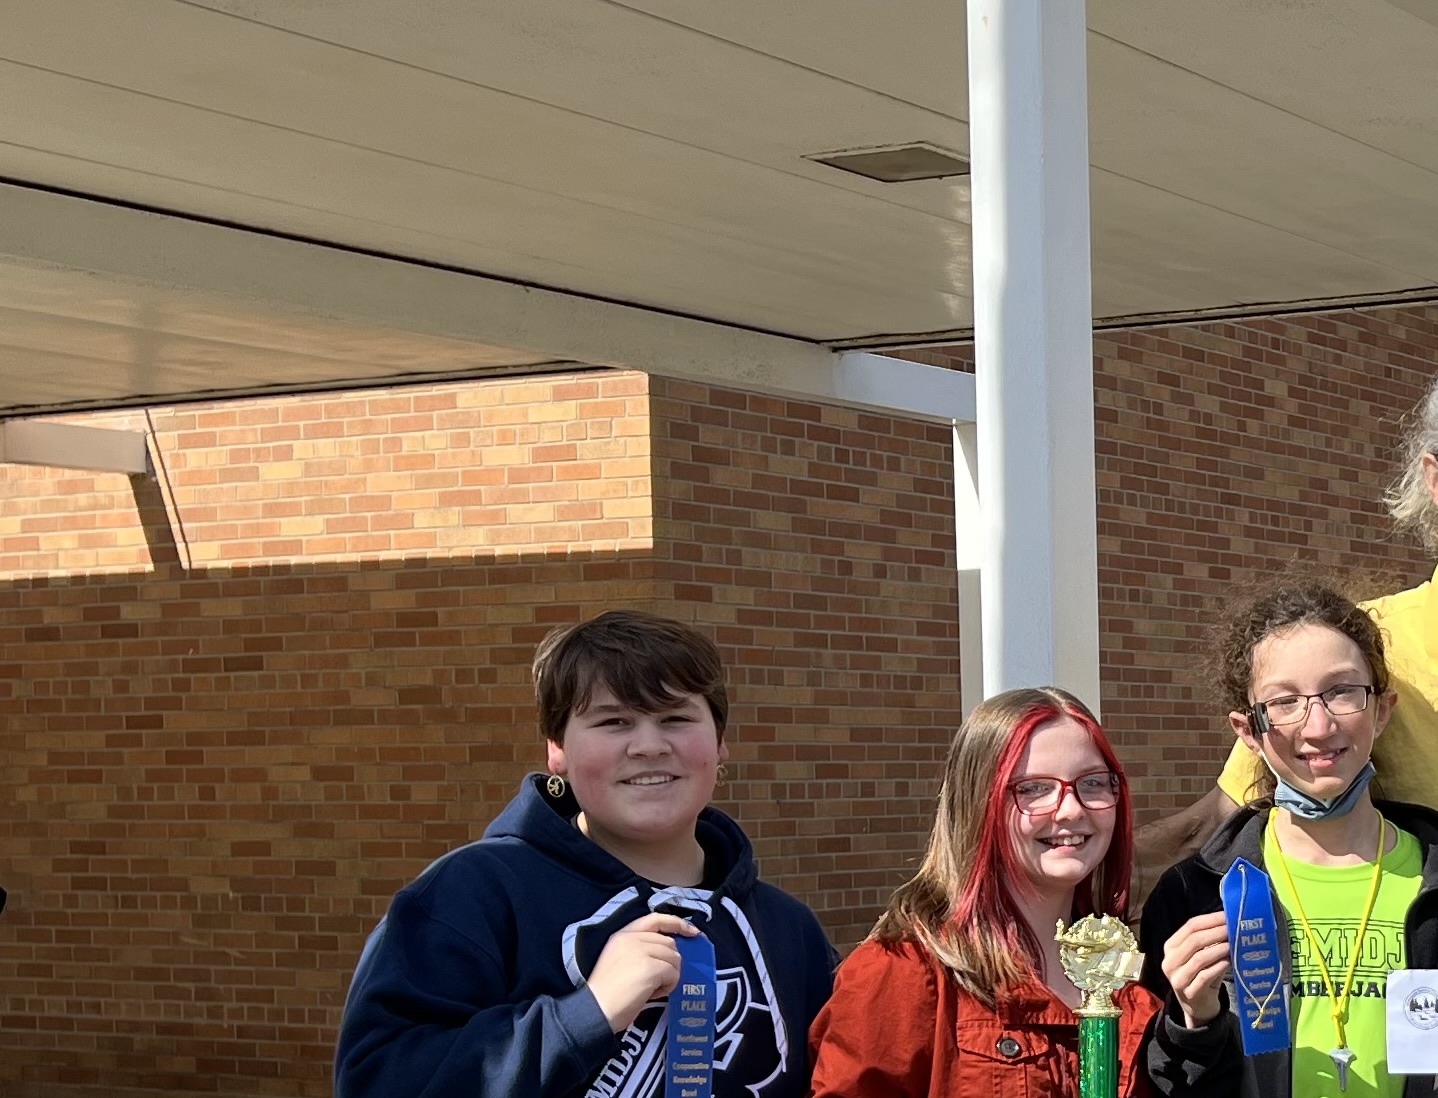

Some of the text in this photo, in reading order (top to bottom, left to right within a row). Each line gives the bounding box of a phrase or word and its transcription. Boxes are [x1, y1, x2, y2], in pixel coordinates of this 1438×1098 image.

[1240, 918, 1264, 931] FIRST
[1241, 933, 1267, 947] PLACE
[1289, 927, 1405, 970] EMIDJ
[682, 984, 706, 996] FIRST
[681, 1000, 707, 1012] PLACE
